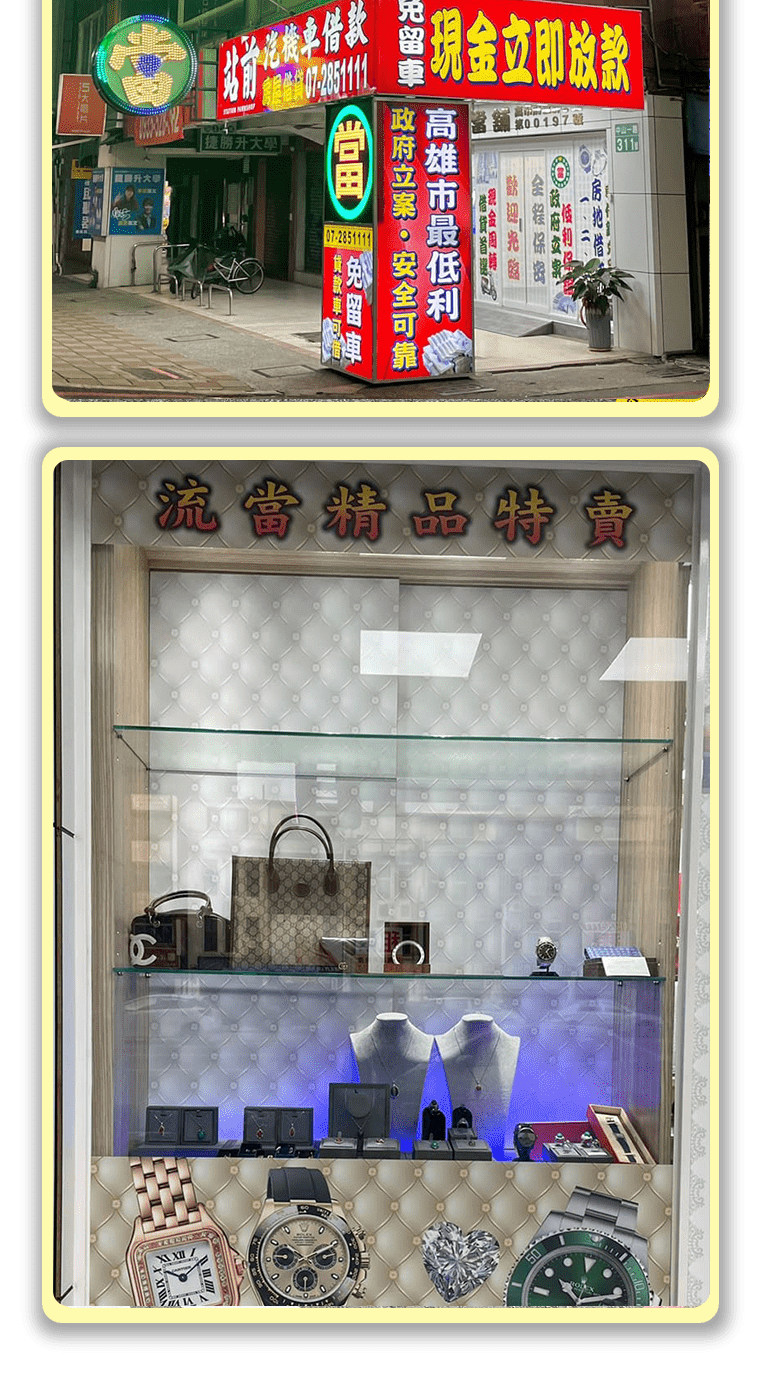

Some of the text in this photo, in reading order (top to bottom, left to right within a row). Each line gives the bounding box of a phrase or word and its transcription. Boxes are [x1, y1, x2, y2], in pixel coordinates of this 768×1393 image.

[223, 35, 260, 102] 站前
[305, 52, 368, 99] 07-2851111
[430, 7, 630, 93] 現金立即放款
[334, 120, 365, 200] 當
[325, 228, 372, 245] 07-2851111
[425, 108, 460, 323] 高雄市最低利
[344, 255, 363, 364] 免留車
[157, 476, 633, 550] 流當精品特賣
[525, 1248, 542, 1265] 50
